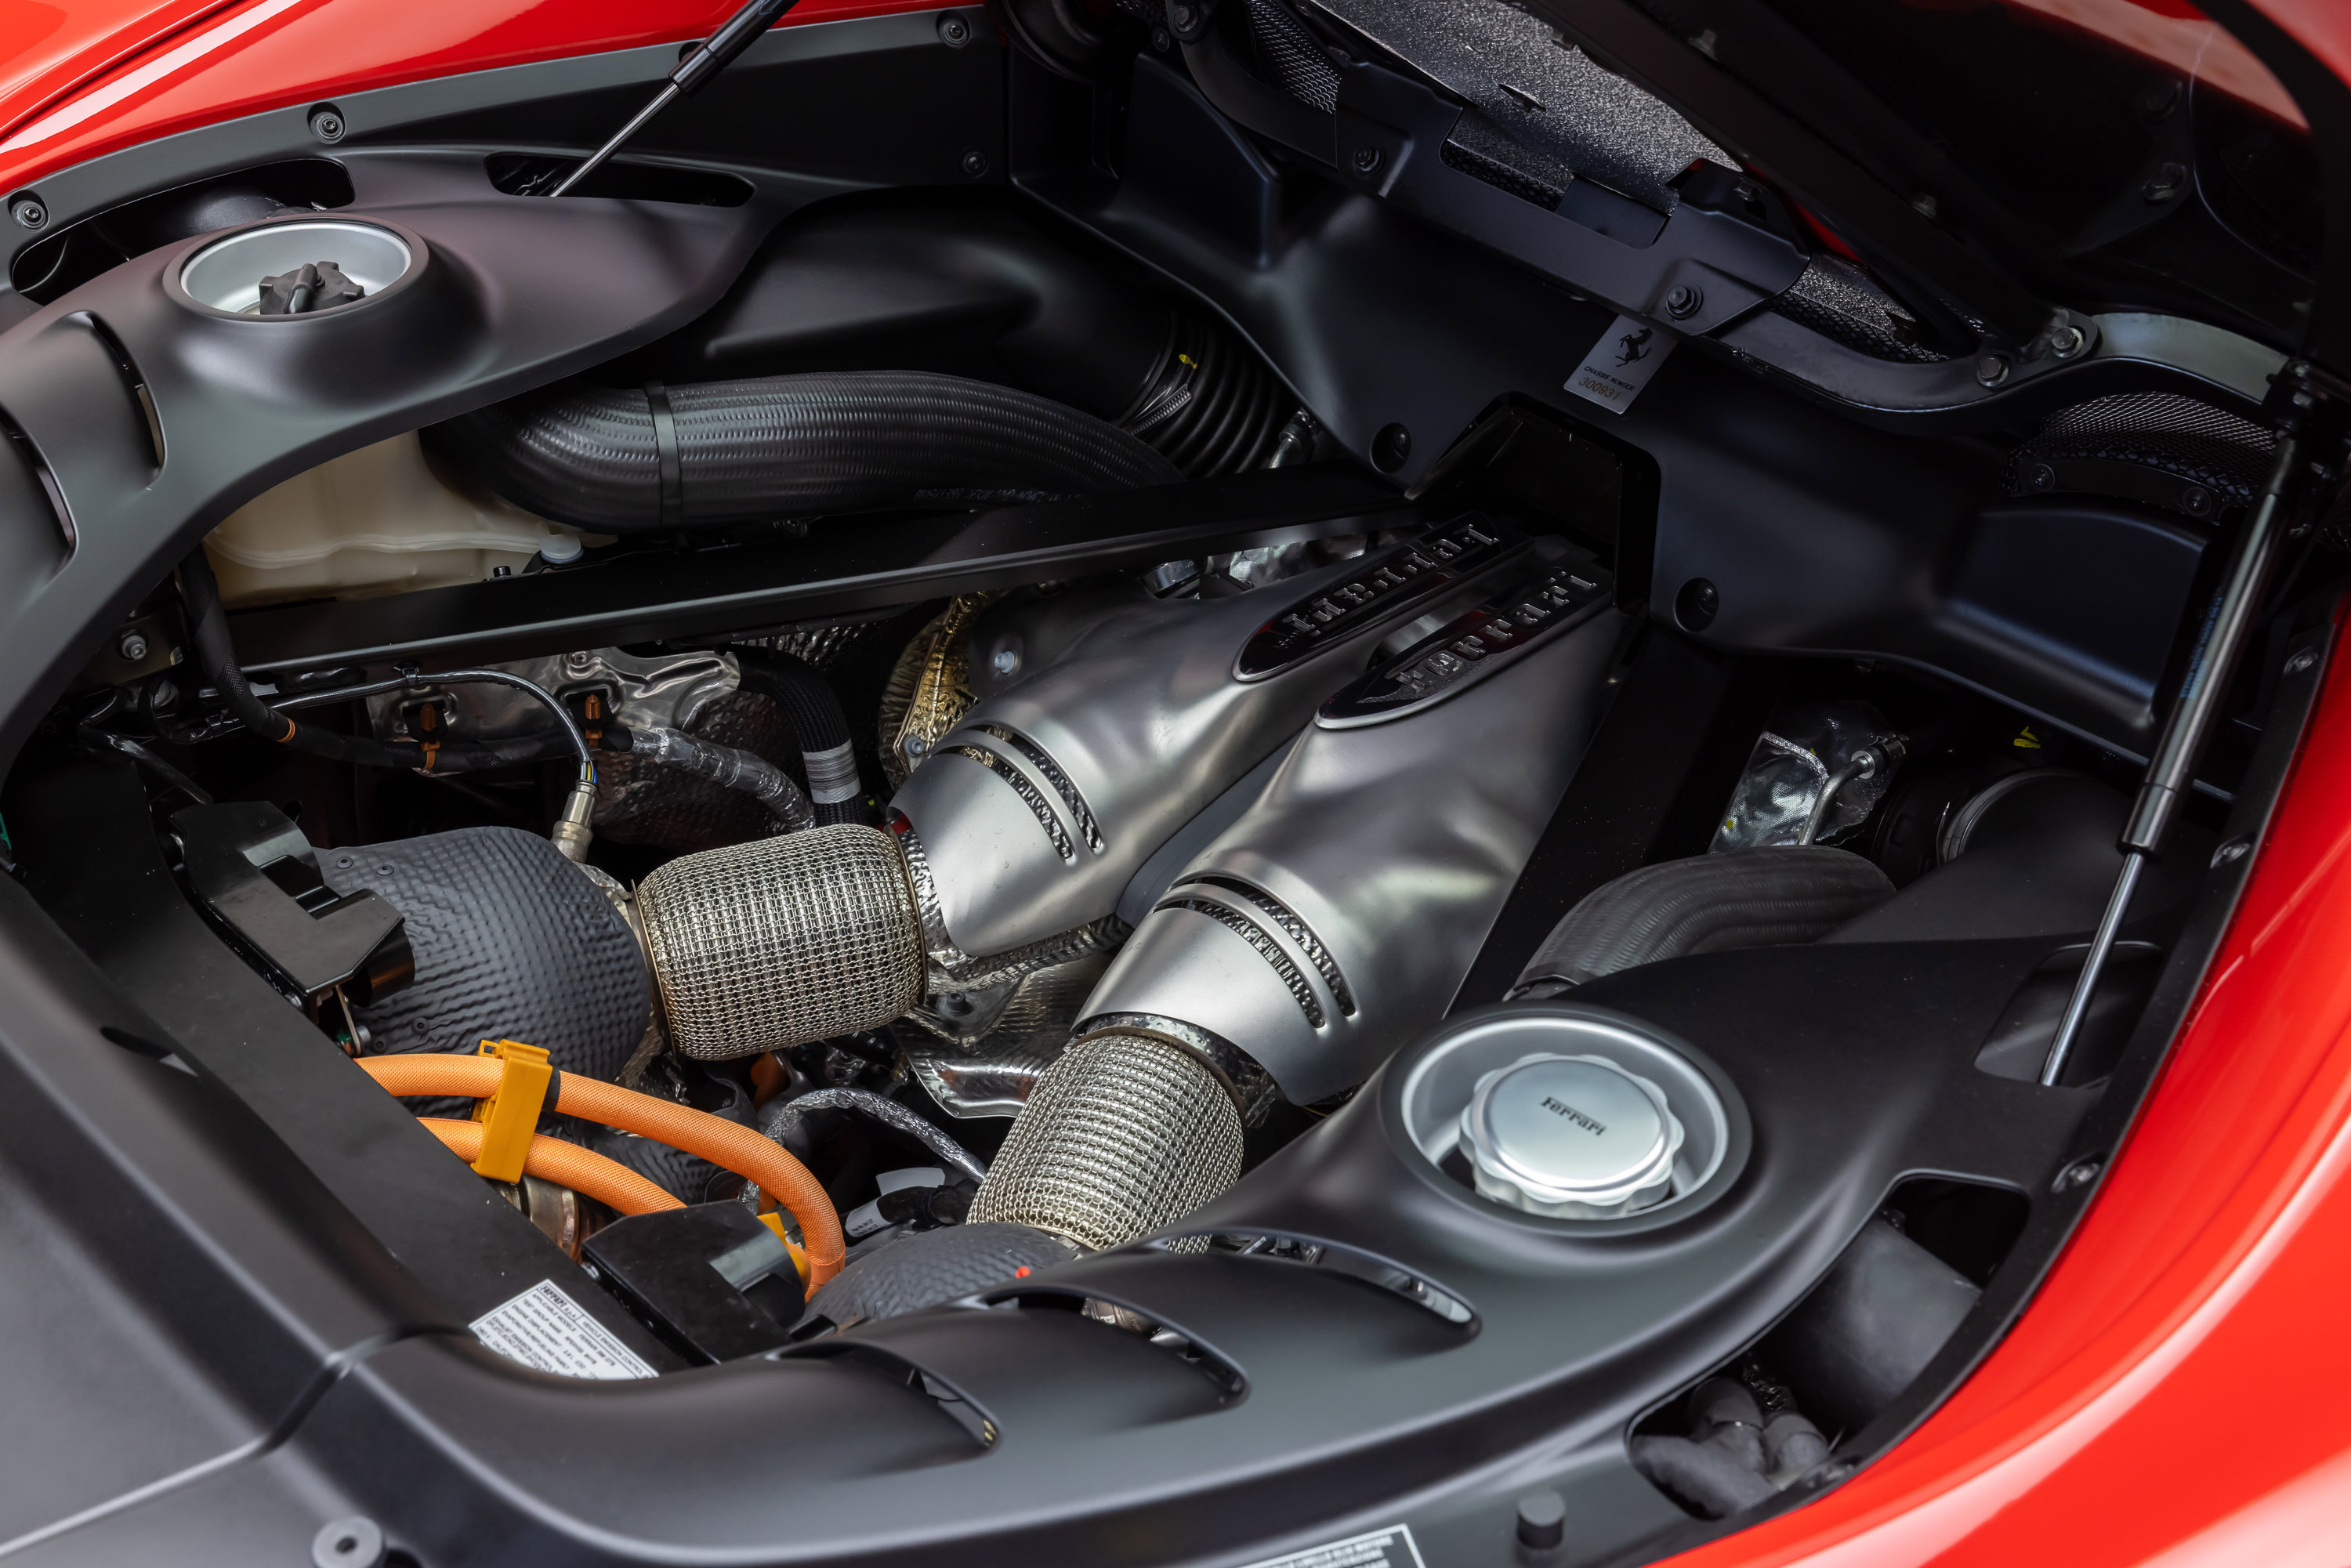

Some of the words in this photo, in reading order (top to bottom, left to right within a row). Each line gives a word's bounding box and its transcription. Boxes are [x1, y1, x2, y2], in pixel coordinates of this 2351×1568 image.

[1578, 377, 1621, 400] 300931
[1584, 366, 1610, 380] CHASSIS
[1610, 377, 1636, 391] NUMBER
[1539, 1095, 1607, 1136] Ferrari
